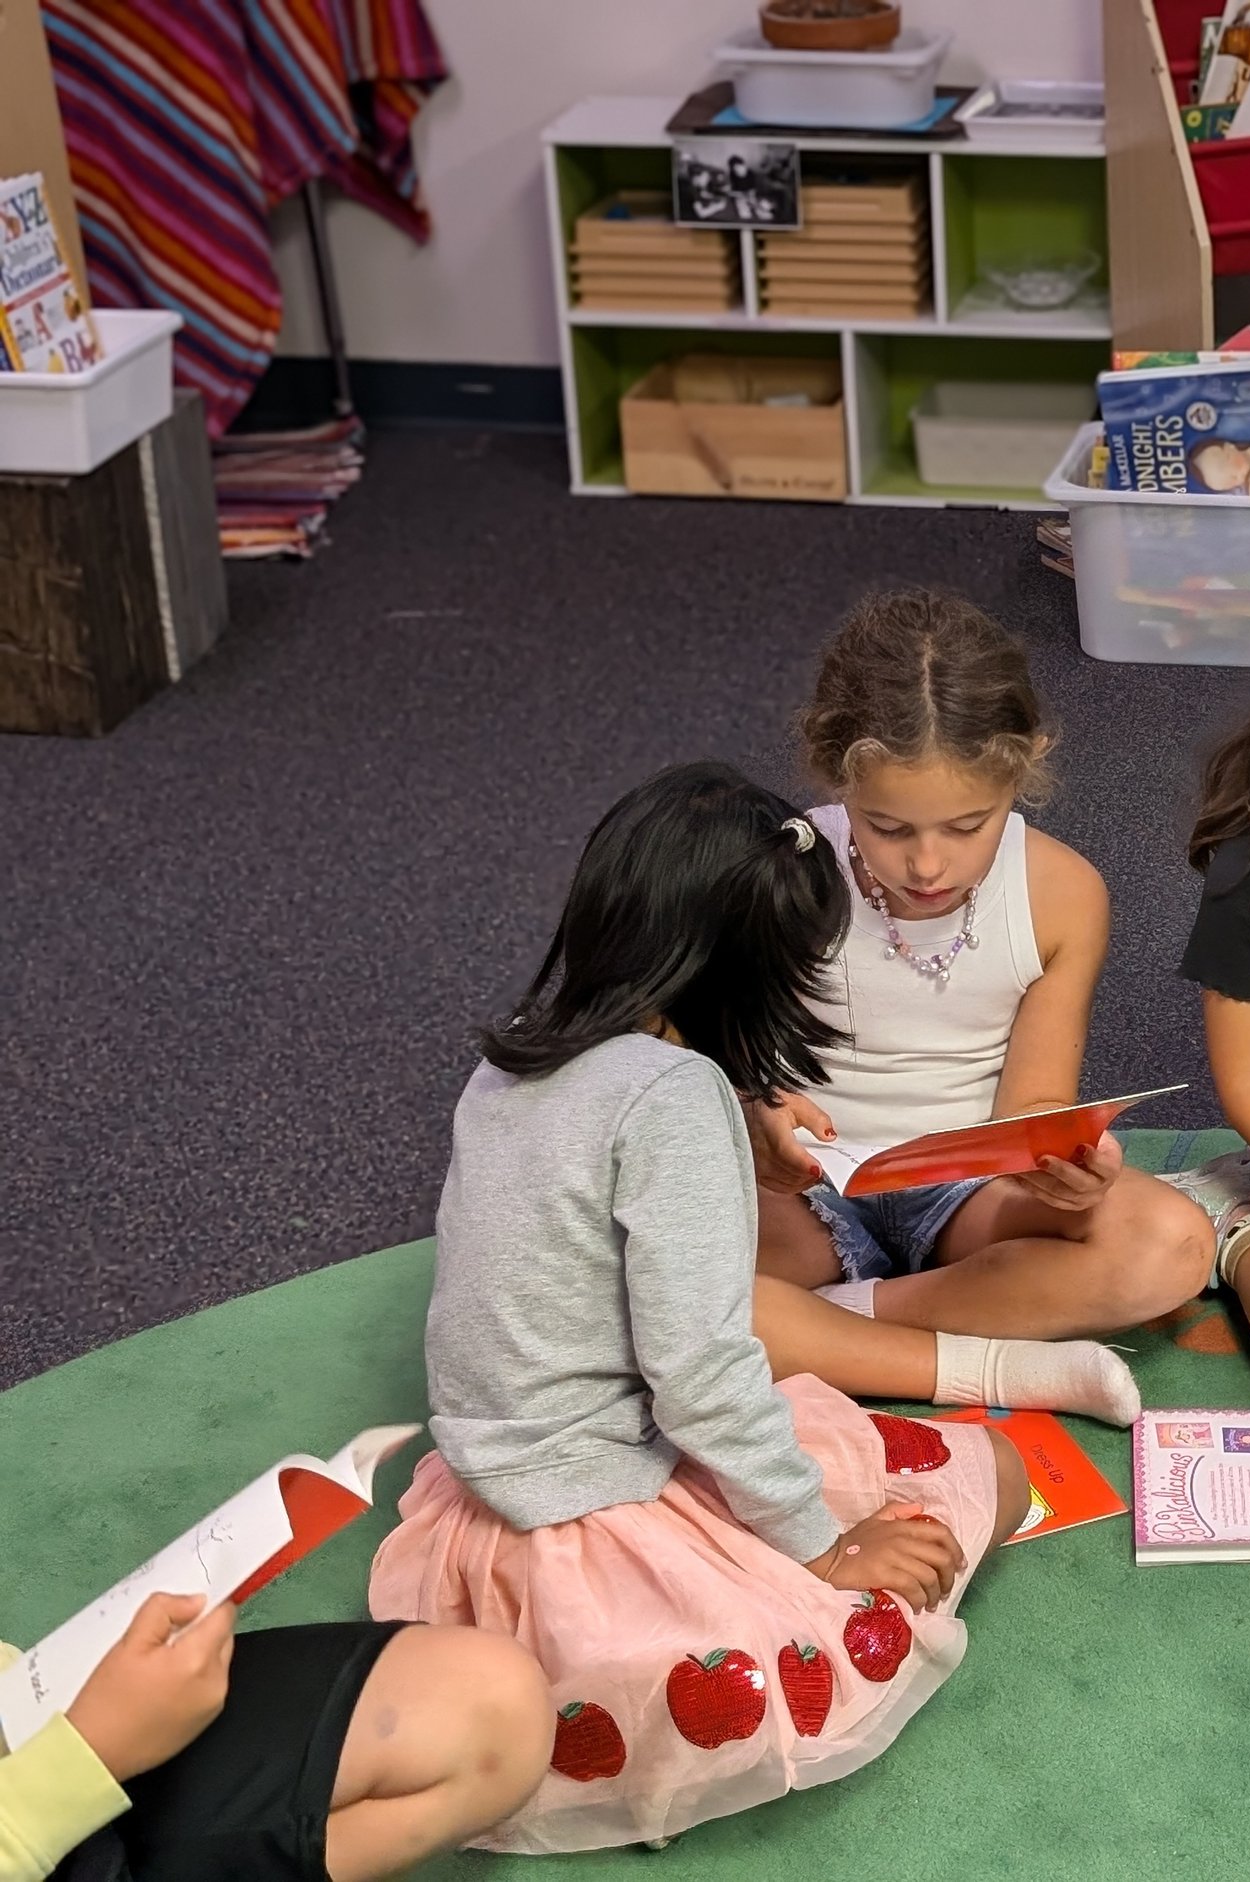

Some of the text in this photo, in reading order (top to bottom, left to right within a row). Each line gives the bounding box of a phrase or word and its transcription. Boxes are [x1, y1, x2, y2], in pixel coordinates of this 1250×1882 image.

[1131, 421, 1159, 492] DNIGHT,
[1155, 414, 1187, 493] MBERS
[1048, 1467, 1065, 1484] Up
[1151, 1452, 1207, 1540] Pinkalicious
